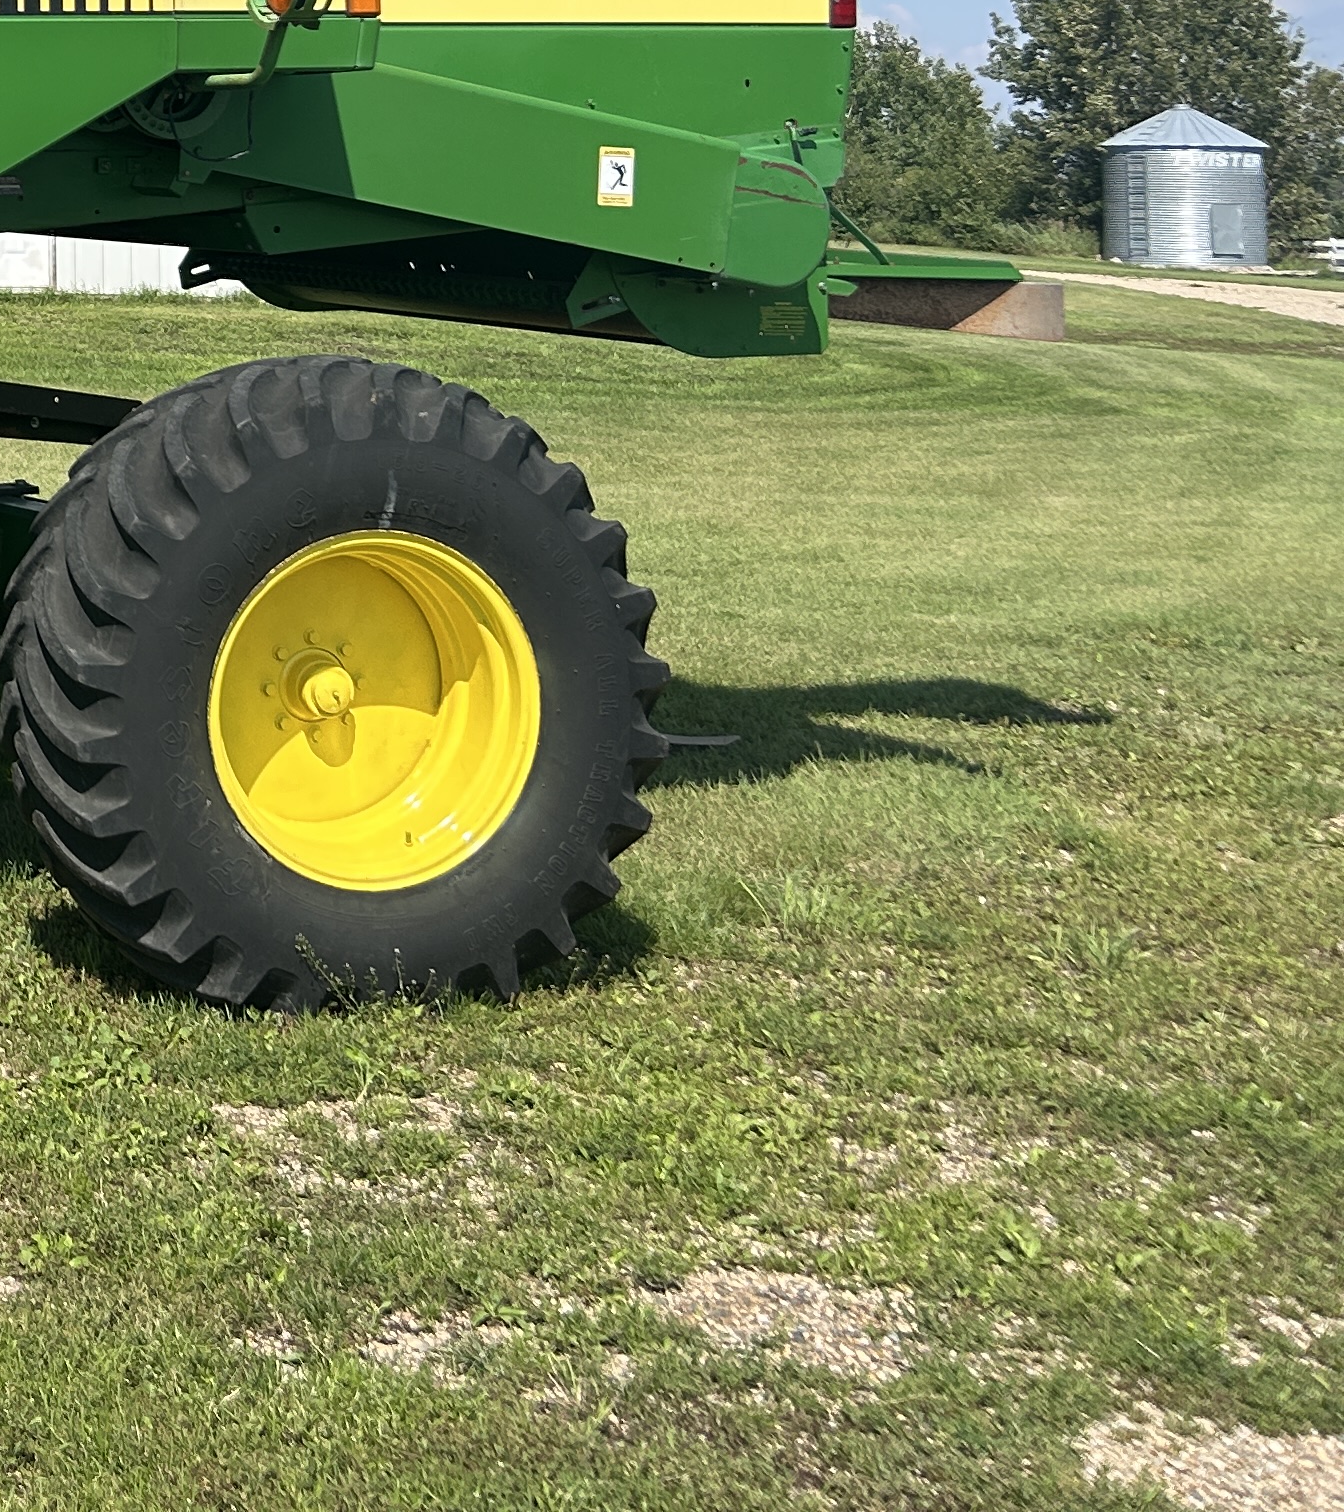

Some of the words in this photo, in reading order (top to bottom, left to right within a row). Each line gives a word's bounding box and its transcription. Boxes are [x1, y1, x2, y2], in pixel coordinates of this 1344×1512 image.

[535, 526, 604, 632] SUPER
[597, 651, 619, 717] ALL
[533, 738, 619, 897] TRACTION
